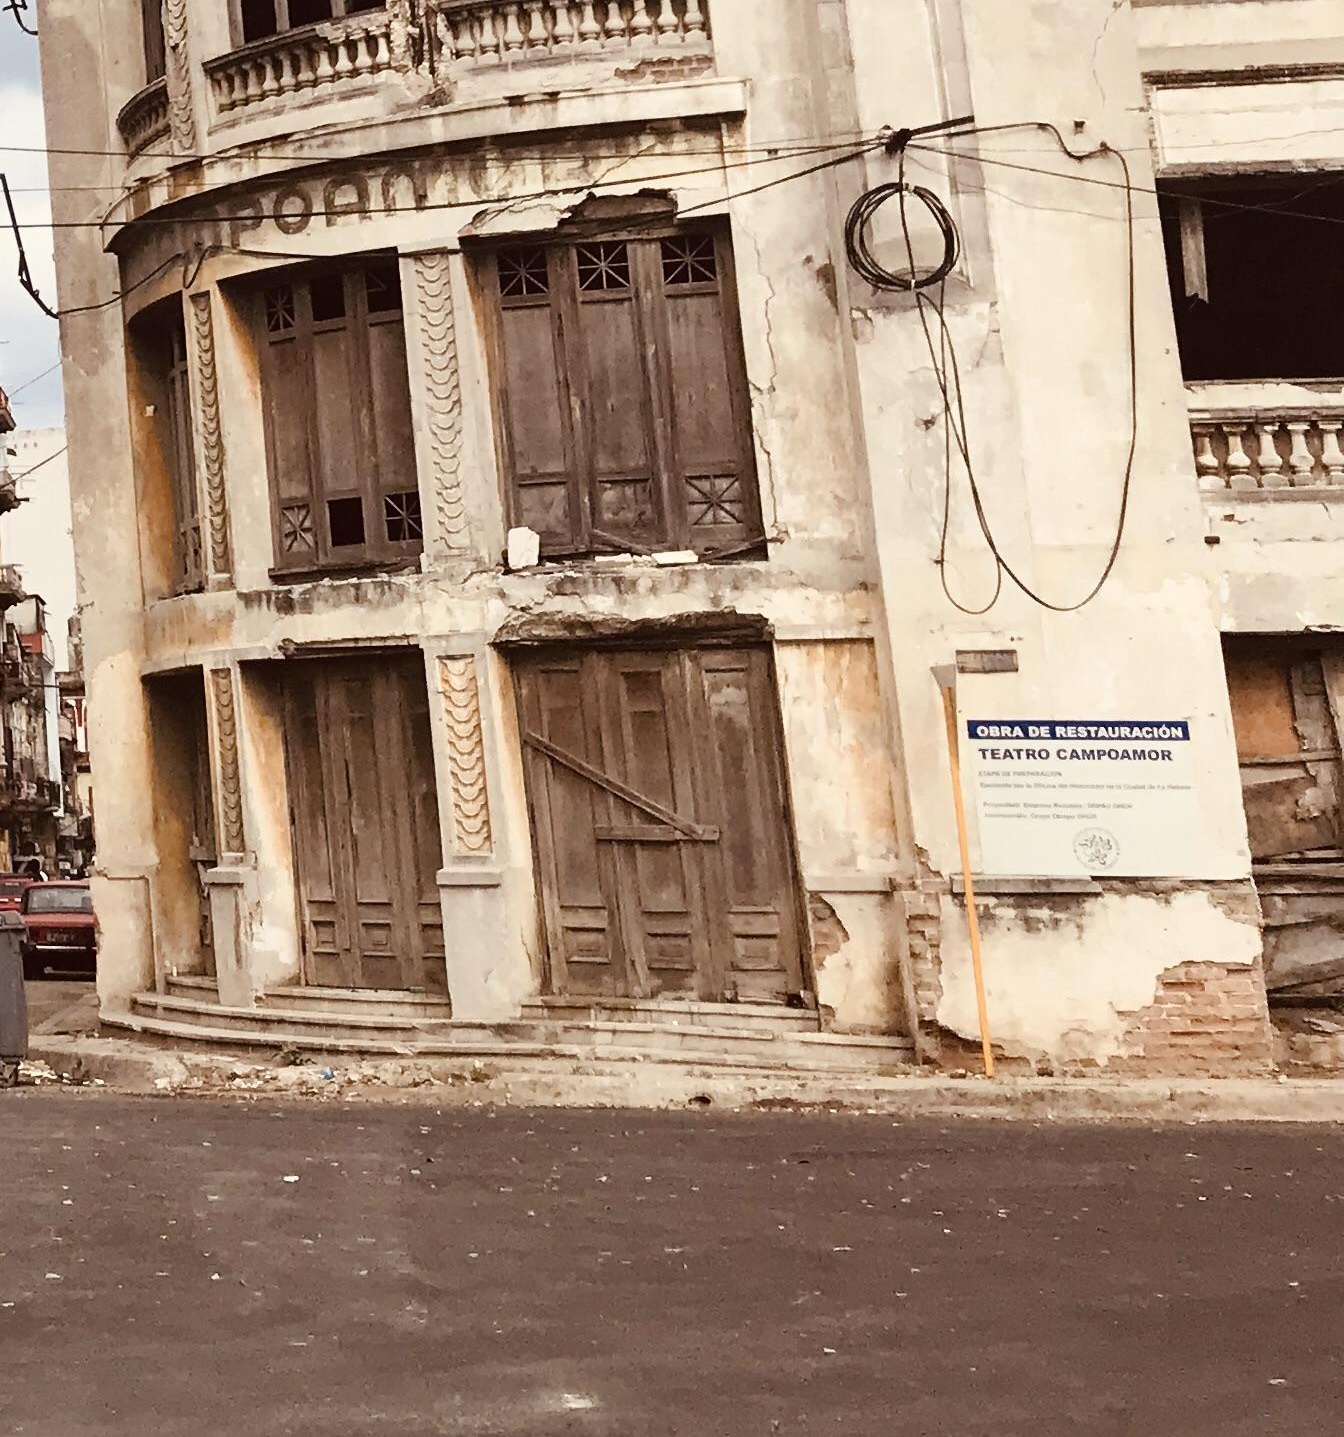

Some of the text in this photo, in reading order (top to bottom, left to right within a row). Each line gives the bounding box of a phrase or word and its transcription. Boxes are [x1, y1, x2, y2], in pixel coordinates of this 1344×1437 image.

[976, 723, 1184, 739] OBRA DE RESTAURACIÓN
[978, 748, 1174, 762] TEATRO CAMPOAMOR
